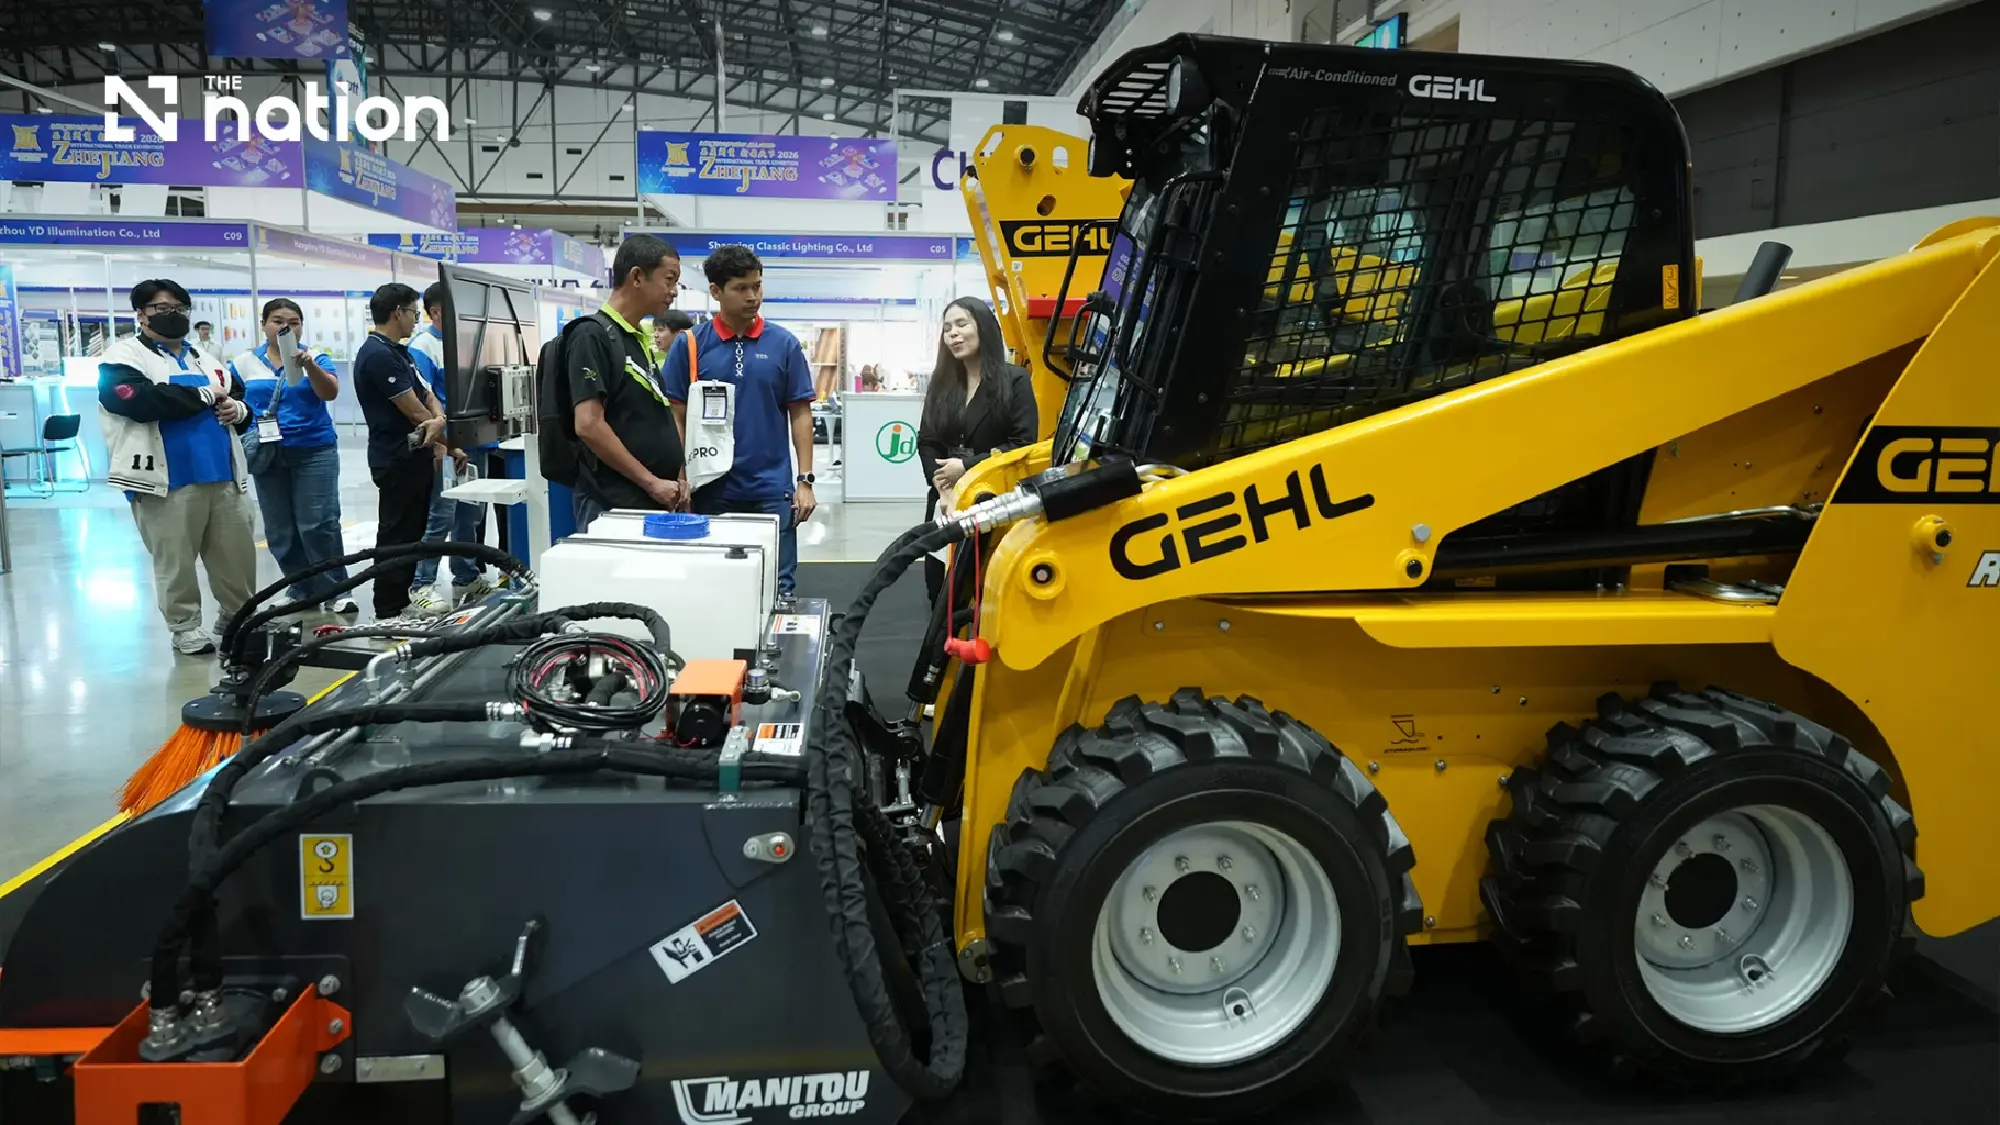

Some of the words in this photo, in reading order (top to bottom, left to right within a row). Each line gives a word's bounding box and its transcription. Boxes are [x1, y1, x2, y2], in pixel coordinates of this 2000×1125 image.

[1289, 68, 1397, 87] Air-Conditioned
[1408, 75, 1497, 102] GEHL
[778, 151, 799, 159] 2026
[29, 226, 44, 236] YD
[47, 226, 115, 237] Illumination
[119, 228, 140, 239] Co.,
[143, 229, 160, 238] Ltd
[756, 241, 790, 251] Classic
[793, 242, 833, 254] Lighting
[836, 243, 855, 253] Co.,
[857, 243, 872, 253] Ltd
[735, 342, 743, 376] TOYOX
[132, 454, 154, 471] 11
[1877, 438, 2000, 493] GE
[1109, 463, 1375, 580] GEHL
[704, 1070, 870, 1112] MANITOU
[789, 1100, 865, 1119] GROUP
